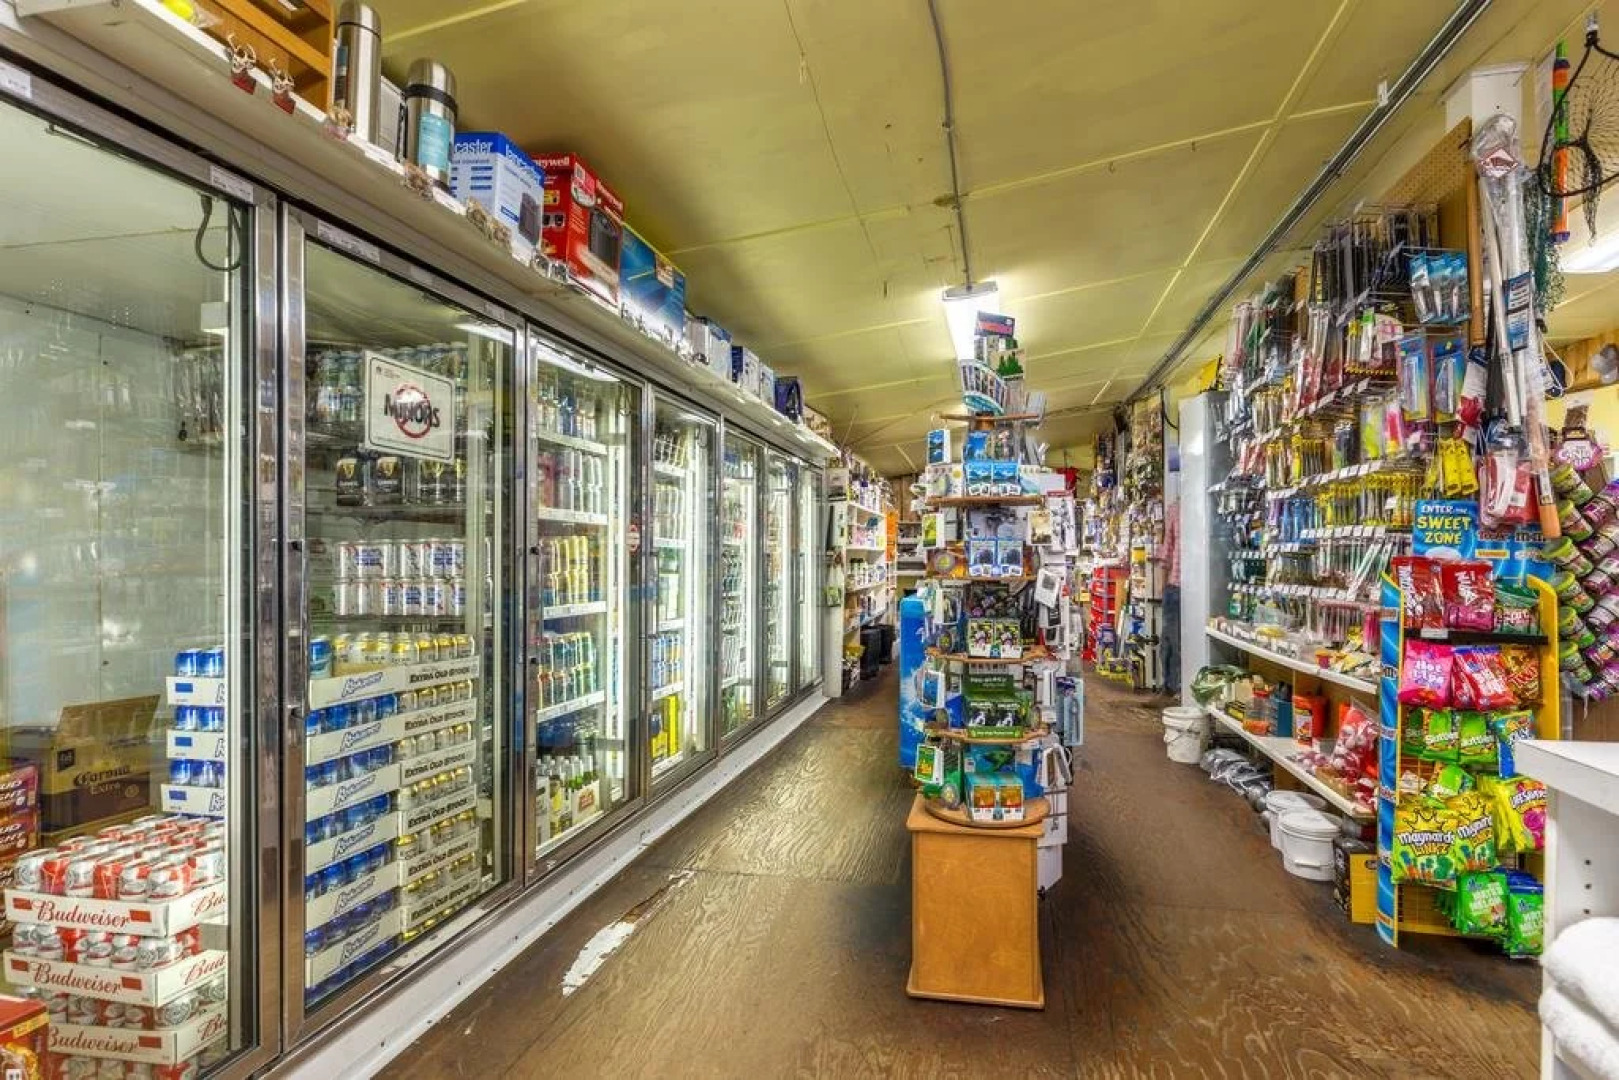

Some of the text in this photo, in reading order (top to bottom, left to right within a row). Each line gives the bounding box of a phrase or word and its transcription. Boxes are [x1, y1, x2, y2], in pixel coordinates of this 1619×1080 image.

[1417, 516, 1471, 530] SWEET
[1424, 532, 1462, 544] ZONE
[411, 673, 433, 683] EXTRA
[434, 670, 448, 679] OLD
[33, 899, 131, 927] Budweiser
[29, 962, 122, 994] Budweiser
[50, 1026, 138, 1054] Budweiser
